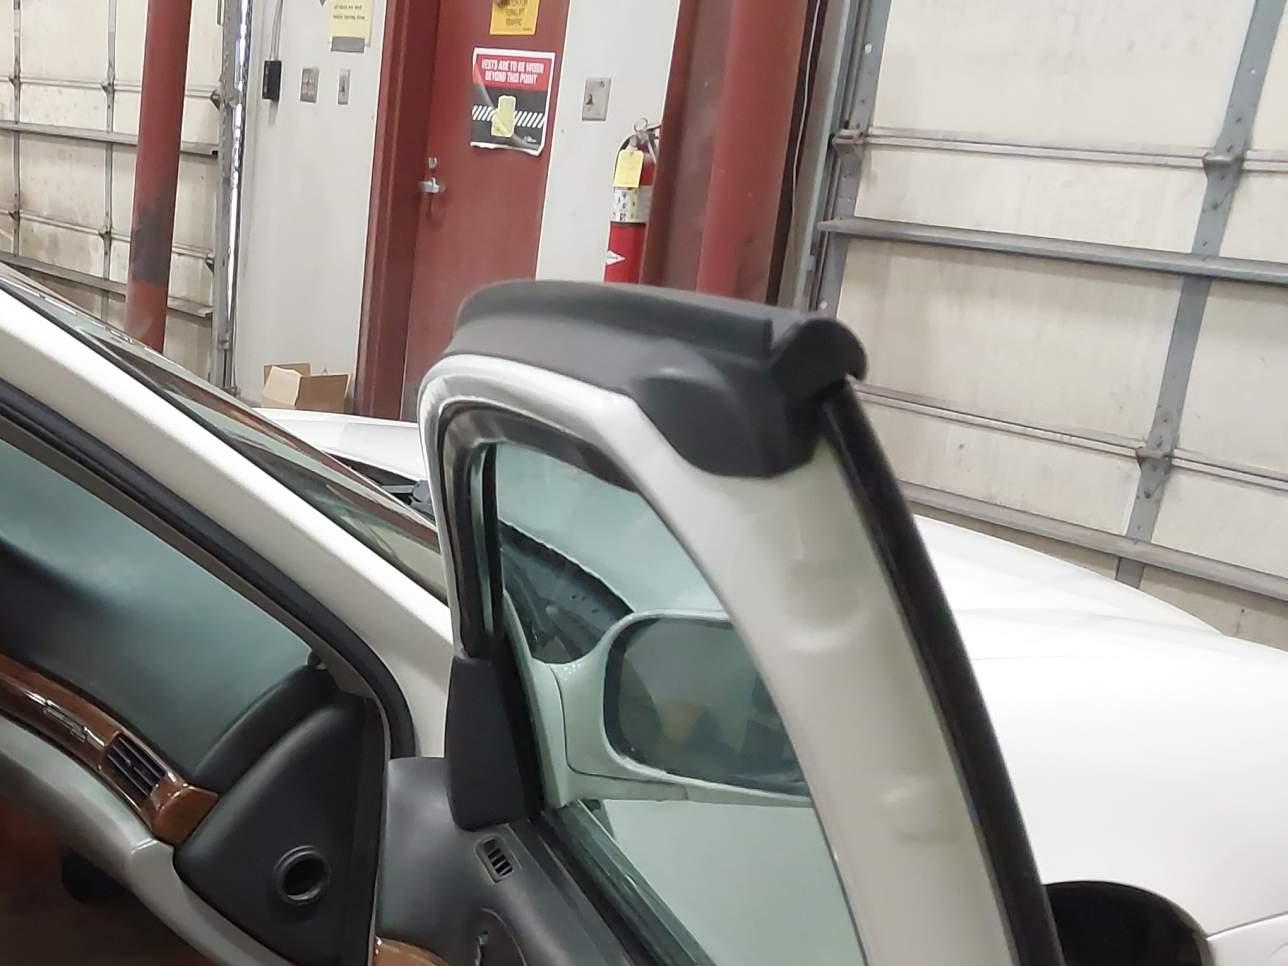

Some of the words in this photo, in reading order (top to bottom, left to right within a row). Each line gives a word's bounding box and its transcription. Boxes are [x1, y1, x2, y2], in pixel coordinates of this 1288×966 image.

[498, 59, 509, 70] ARE
[510, 60, 517, 72] TO
[518, 61, 525, 73] BE
[485, 70, 507, 82] BEYOND
[507, 71, 519, 83] THIS
[520, 73, 538, 85] POINT
